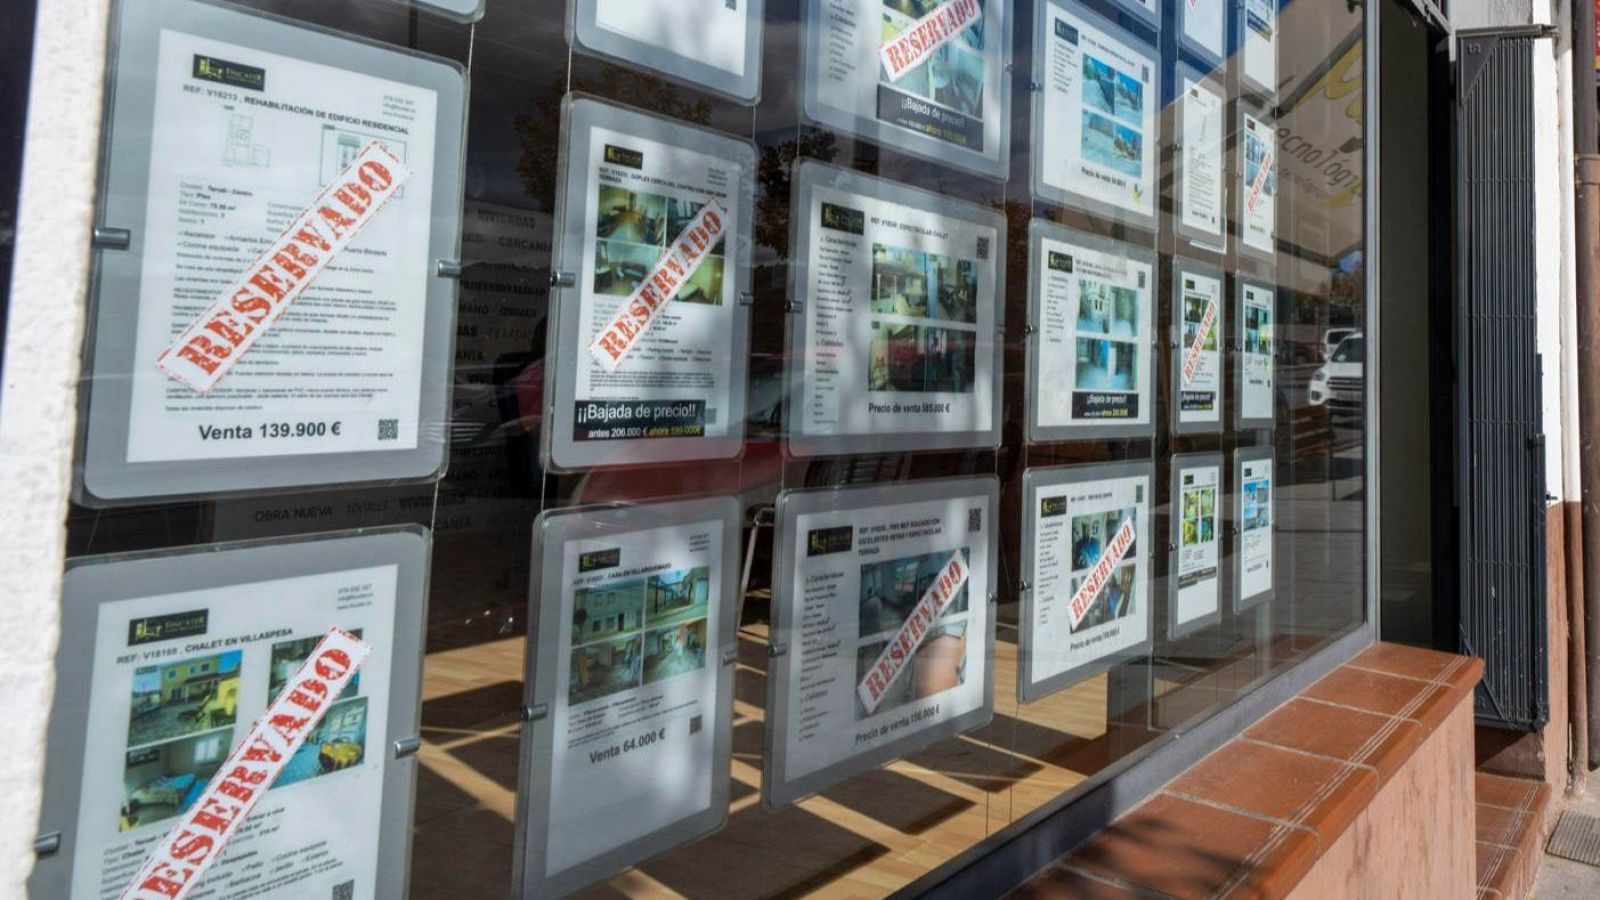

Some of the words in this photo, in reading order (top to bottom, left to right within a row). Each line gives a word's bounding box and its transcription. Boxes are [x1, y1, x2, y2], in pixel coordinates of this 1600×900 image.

[886, 0, 976, 73] RESERVADO
[315, 109, 327, 119] DE
[328, 113, 361, 126] EDIFICIO
[362, 119, 409, 135] RESIDENCIAL
[176, 160, 394, 376] RESERVADO
[599, 210, 722, 361] RESERVADO
[577, 403, 632, 423] ¡¡Bajada
[635, 405, 651, 418] de
[653, 404, 697, 421] precio!!
[868, 402, 893, 414] Precio
[893, 402, 902, 413] de
[199, 424, 253, 442] Venta
[259, 421, 326, 438] 139.900
[330, 421, 341, 437] €
[588, 427, 610, 439] antes
[254, 508, 290, 523] OBRA
[294, 506, 333, 520] NUEVA
[1071, 524, 1131, 621] RESERVADO
[185, 639, 223, 653] CHALET
[225, 636, 238, 648] EN
[239, 627, 293, 646] VILLASPESA
[865, 560, 962, 701] RESERVADO
[589, 745, 621, 764] Venta
[623, 731, 657, 753] 64.000
[659, 727, 665, 740] €
[855, 729, 879, 746] Precio
[880, 724, 889, 737] de
[890, 716, 910, 732] venta
[132, 648, 352, 900] ESERVADO
